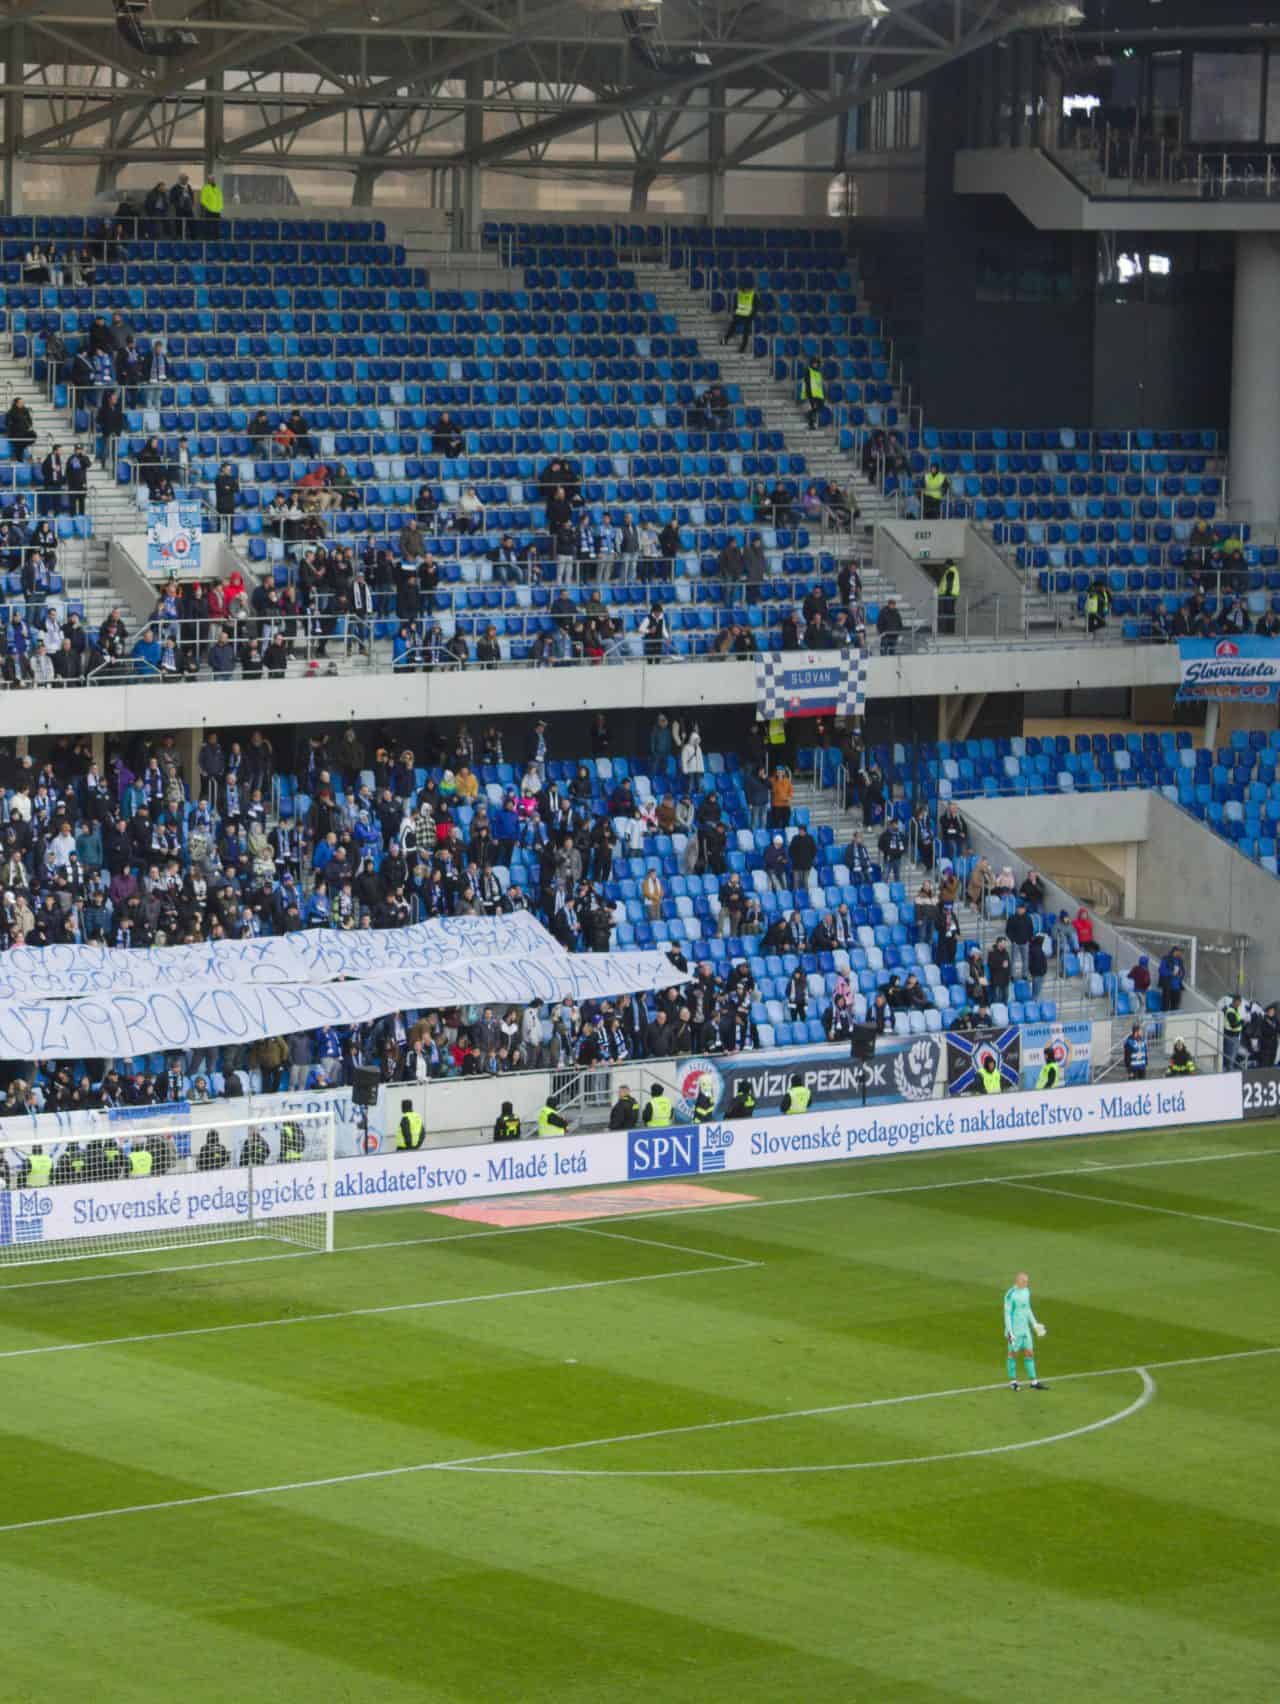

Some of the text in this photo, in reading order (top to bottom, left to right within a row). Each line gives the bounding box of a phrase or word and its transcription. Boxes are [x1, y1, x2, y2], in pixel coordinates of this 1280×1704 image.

[791, 671, 831, 686] SLOVAN
[1184, 662, 1278, 684] Slovanista
[111, 988, 270, 1054] ROKOV
[1243, 1081, 1280, 1108] 23:3
[750, 1126, 841, 1157] Slovenské
[846, 1111, 956, 1155] pedagogické
[959, 1102, 1084, 1136] nakladateľstvo
[1099, 1096, 1153, 1121] Mladé
[1156, 1092, 1187, 1115] letá
[633, 1135, 694, 1170] SPN
[73, 1188, 180, 1224] Slovenské
[187, 1175, 315, 1220] pedagogické
[486, 1153, 547, 1184] Mladé
[553, 1147, 589, 1175] letá
